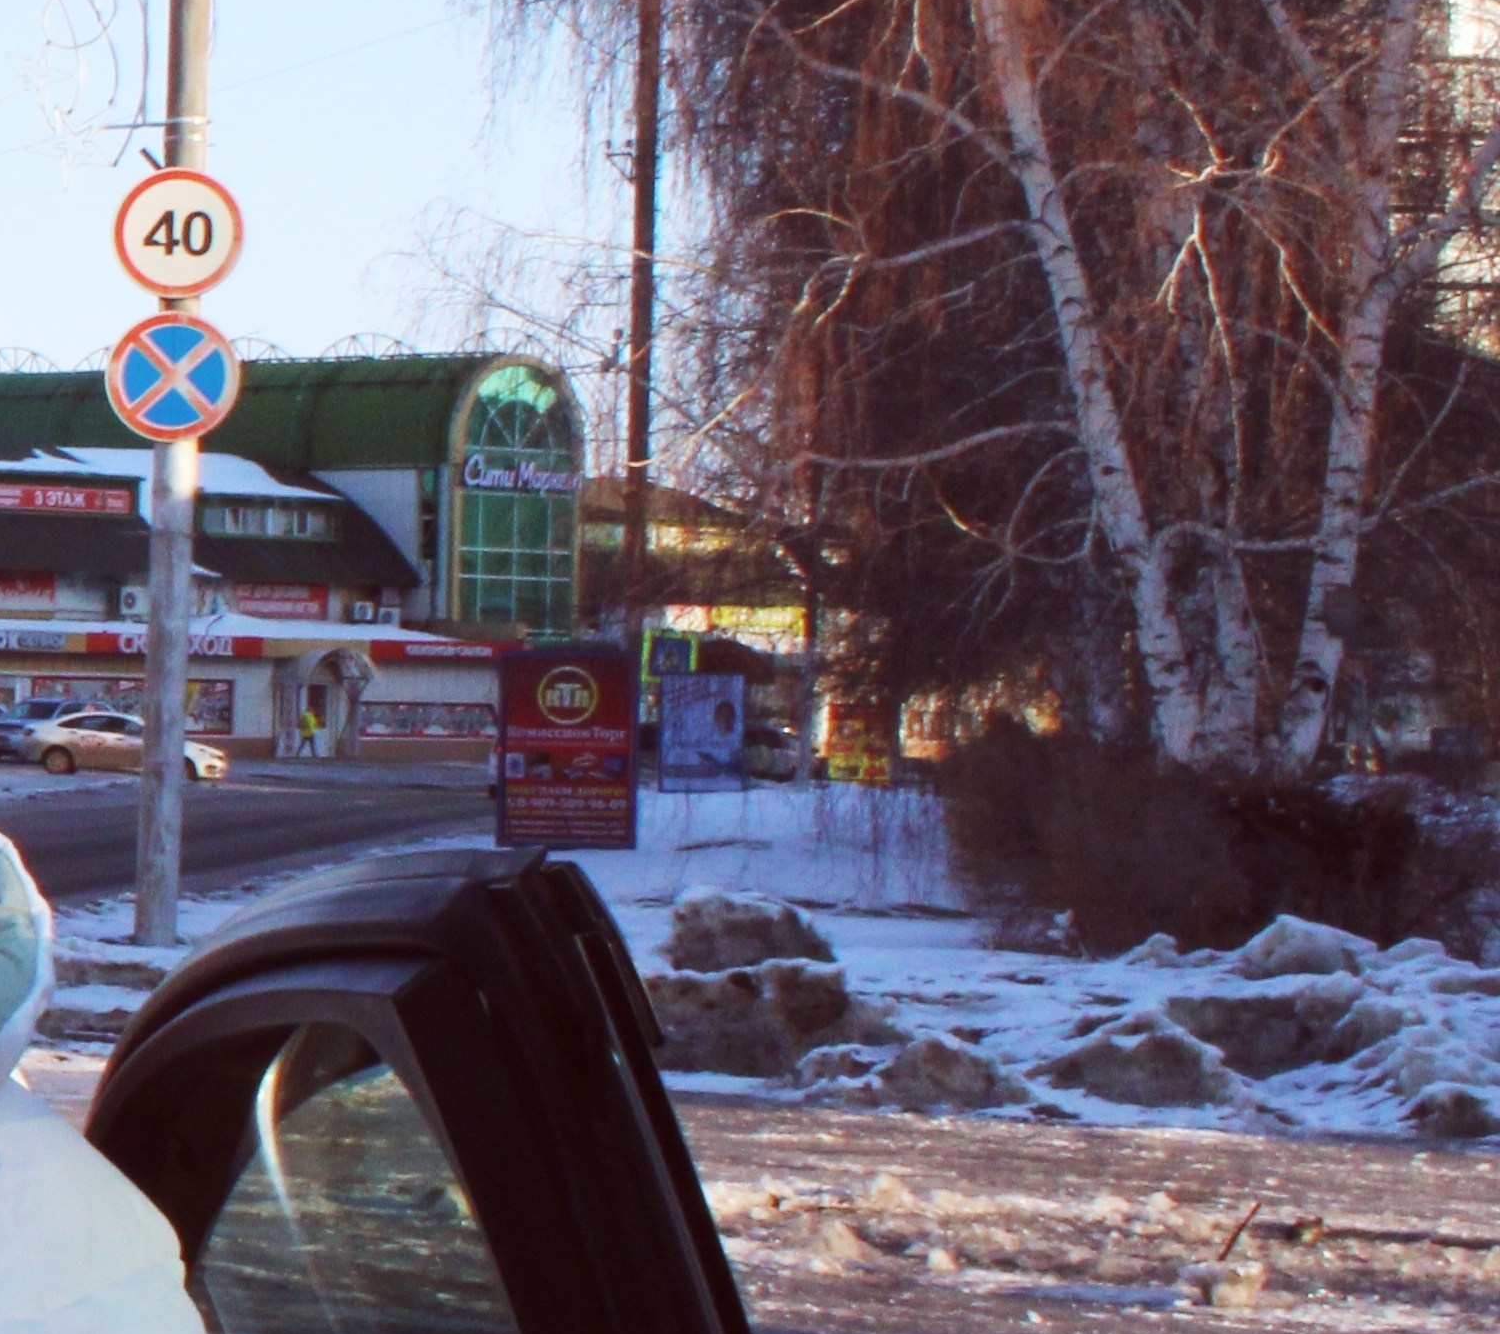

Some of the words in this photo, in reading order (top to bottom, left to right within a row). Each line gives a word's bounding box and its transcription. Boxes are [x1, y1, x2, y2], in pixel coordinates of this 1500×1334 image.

[143, 210, 212, 256] 40
[33, 490, 44, 506] 3
[48, 491, 86, 508] ЭТАЖ
